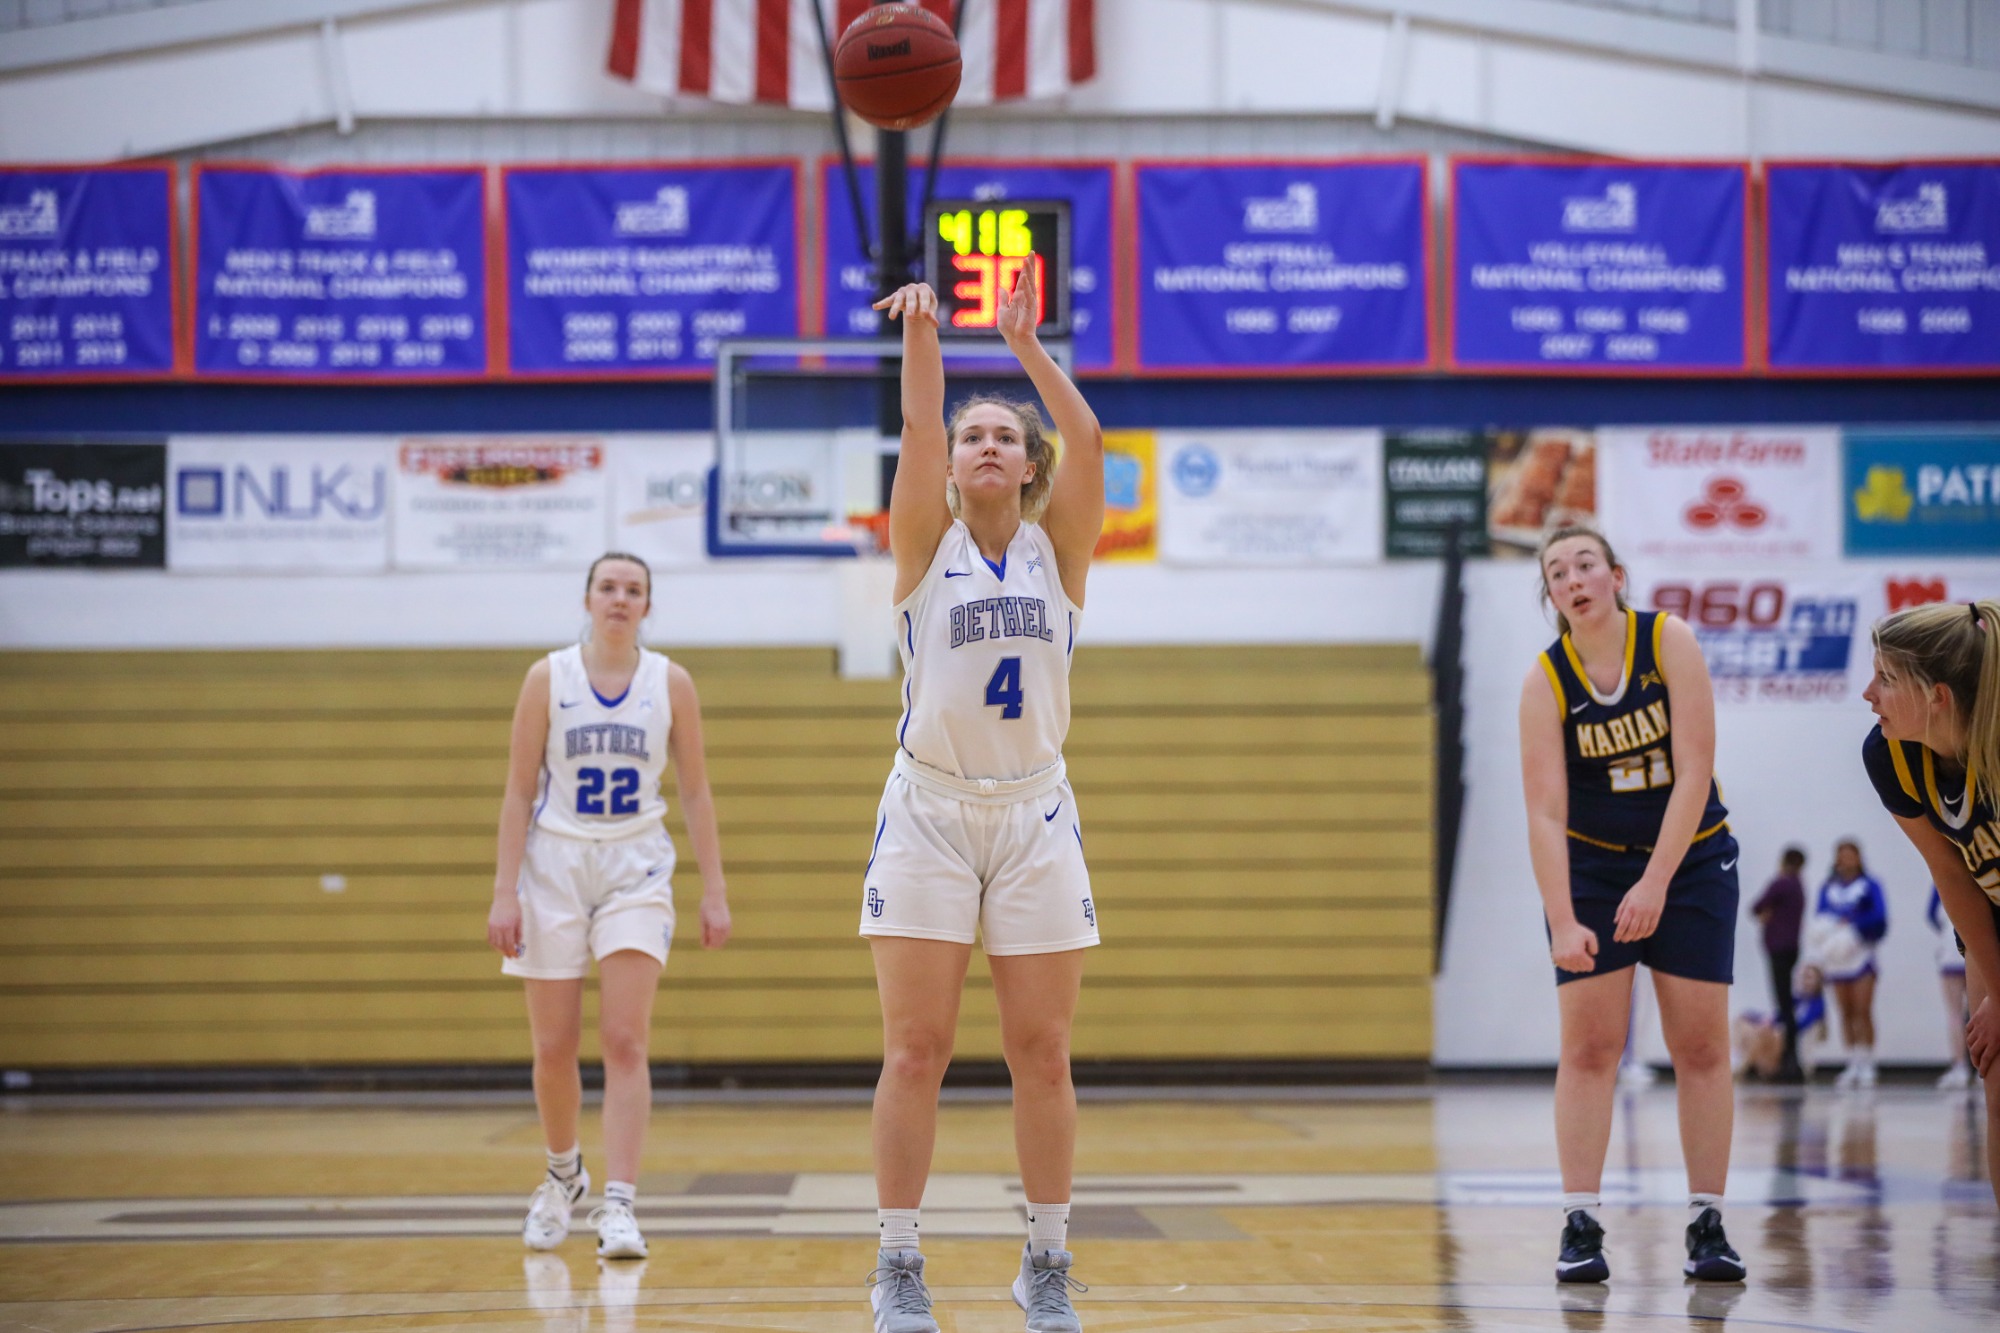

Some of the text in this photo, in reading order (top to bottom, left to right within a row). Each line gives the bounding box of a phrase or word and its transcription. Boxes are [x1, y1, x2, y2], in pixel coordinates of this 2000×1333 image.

[234, 465, 387, 520] NLKJ
[950, 597, 1053, 649] BETHEL
[1650, 582, 1784, 630] 960
[984, 656, 1024, 720] 4
[565, 722, 649, 760] BETHEL
[1577, 699, 1670, 758] MARIAN
[576, 767, 640, 815] 22
